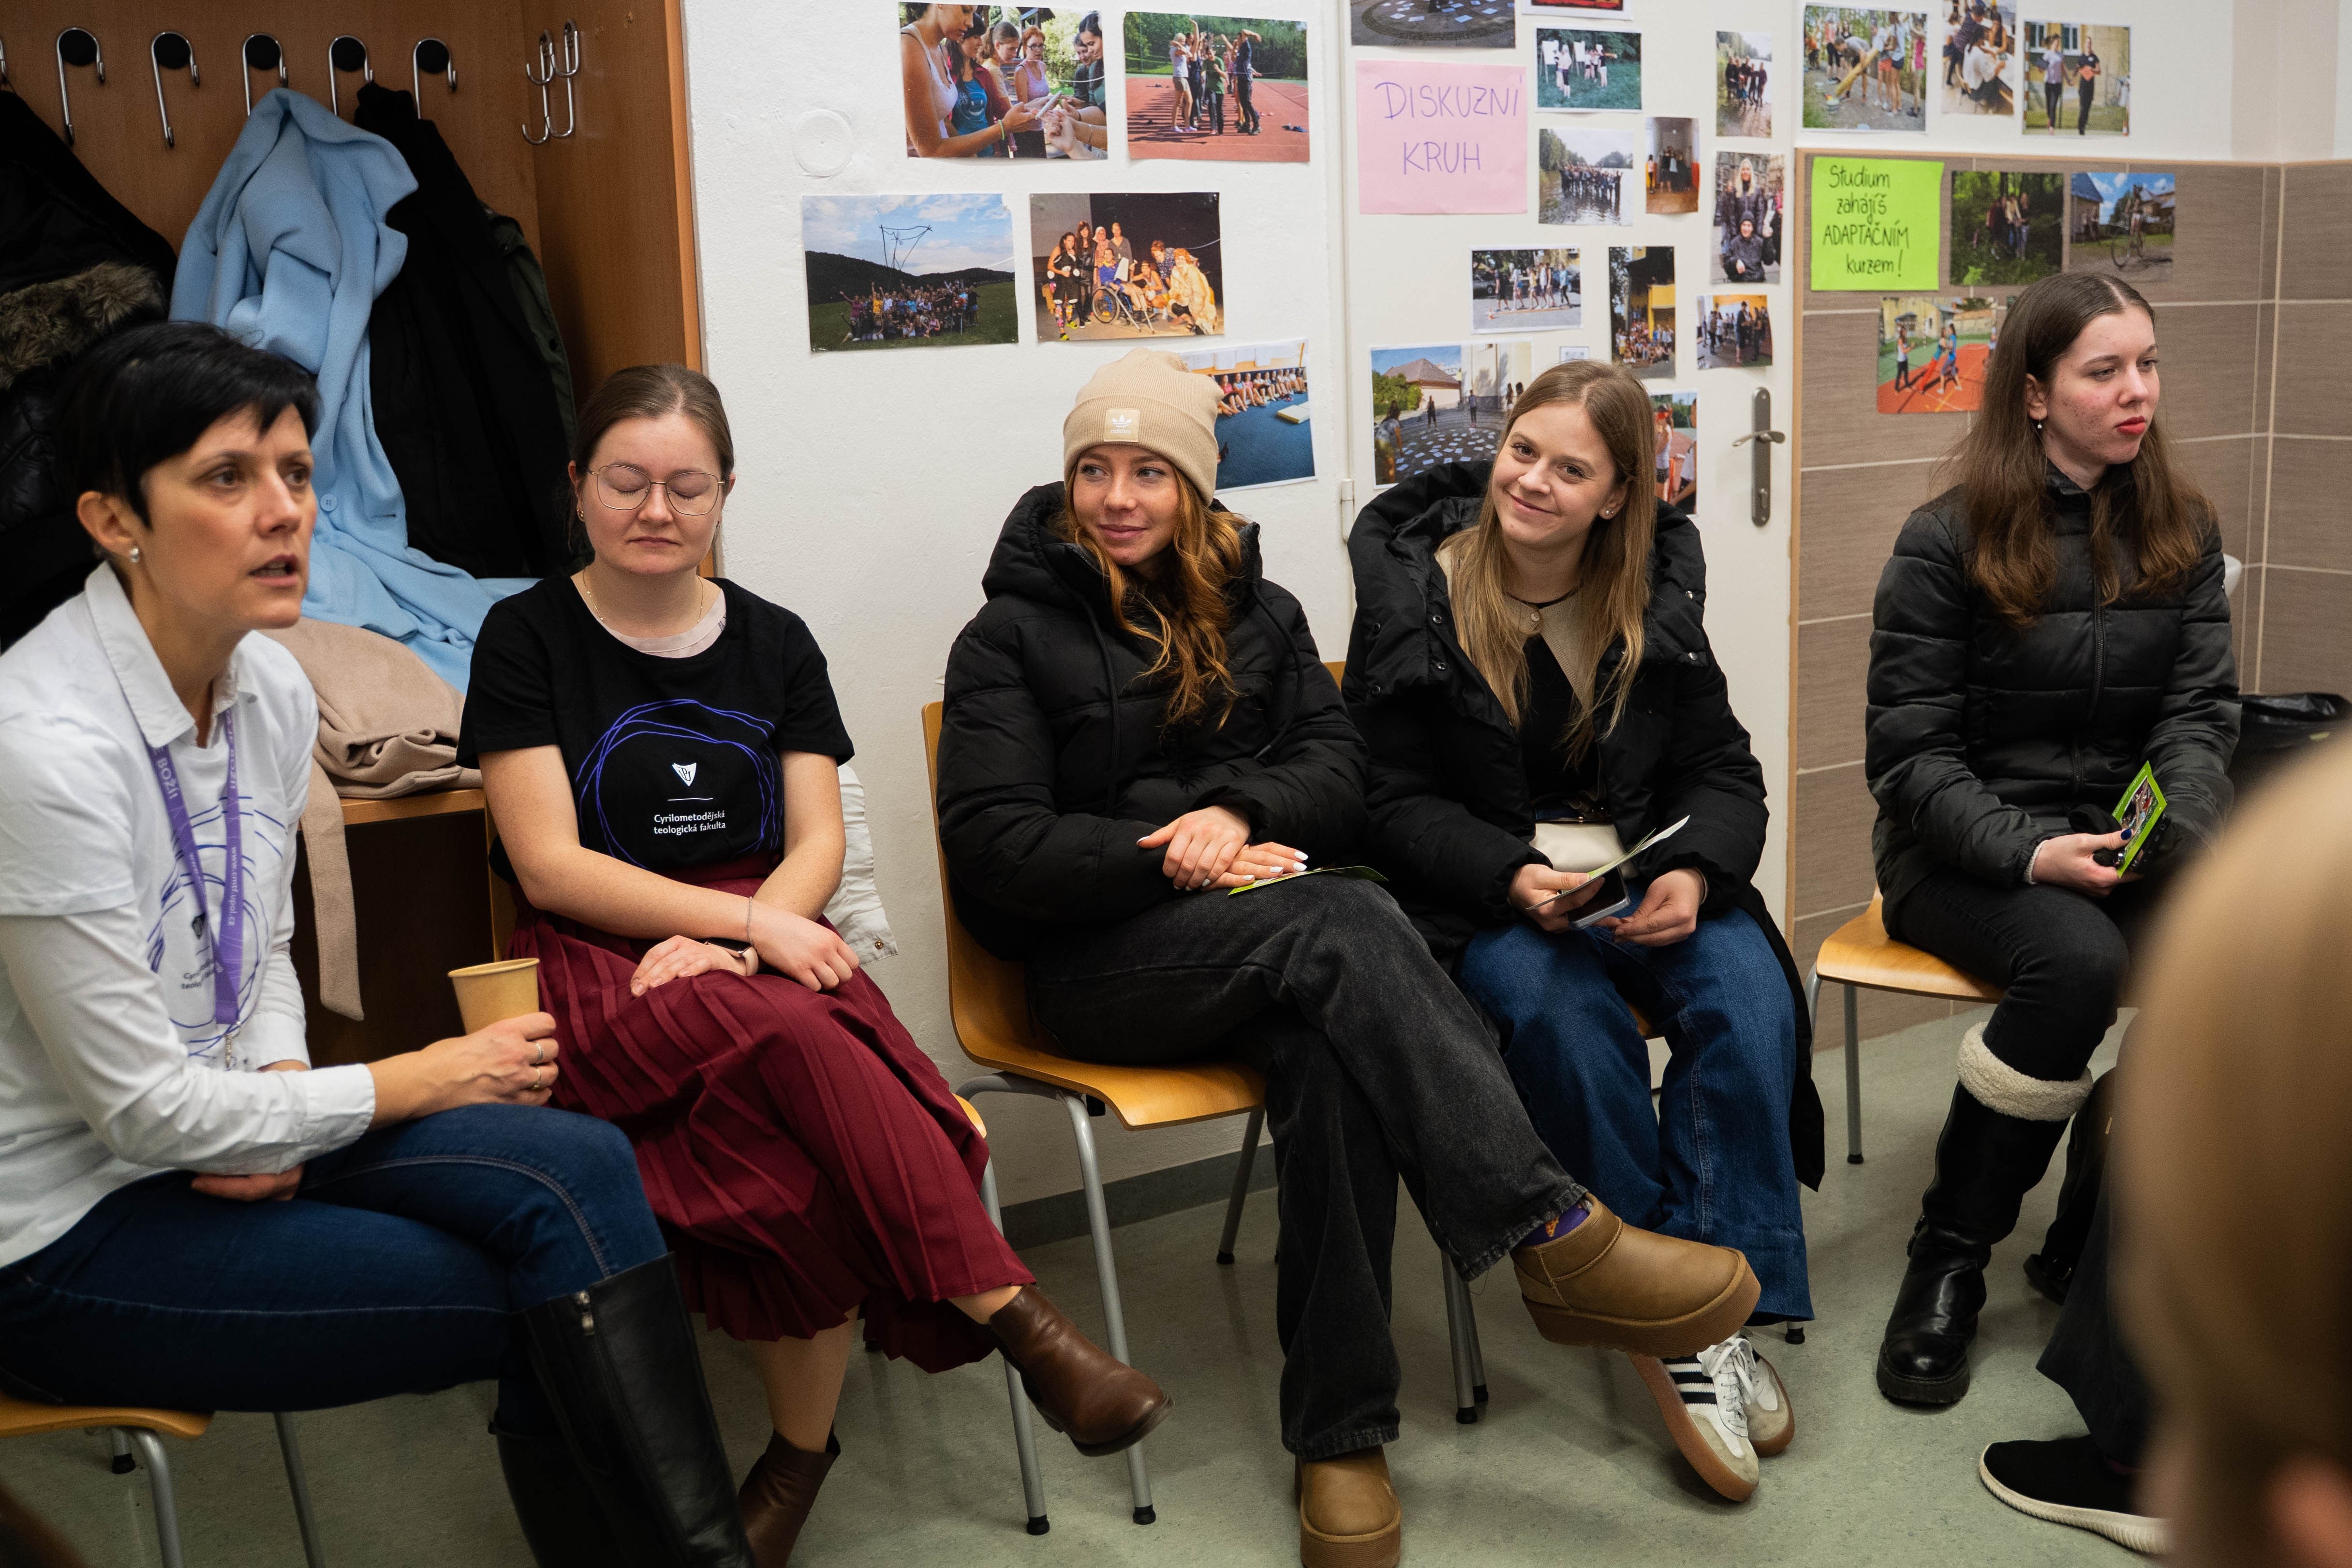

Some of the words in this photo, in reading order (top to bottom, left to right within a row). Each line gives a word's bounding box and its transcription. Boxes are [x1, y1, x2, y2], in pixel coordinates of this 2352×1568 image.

[1375, 75, 1523, 120] DISKUZNÍ
[1403, 141, 1481, 175] KRUH
[1828, 164, 1890, 188] Studium
[1836, 192, 1887, 224] zahájíš
[1822, 219, 1910, 249] ADAPTAČNÍM
[653, 824, 697, 836] teologická
[700, 821, 726, 831] fakulta
[654, 810, 725, 824] Cyrilometodějská
